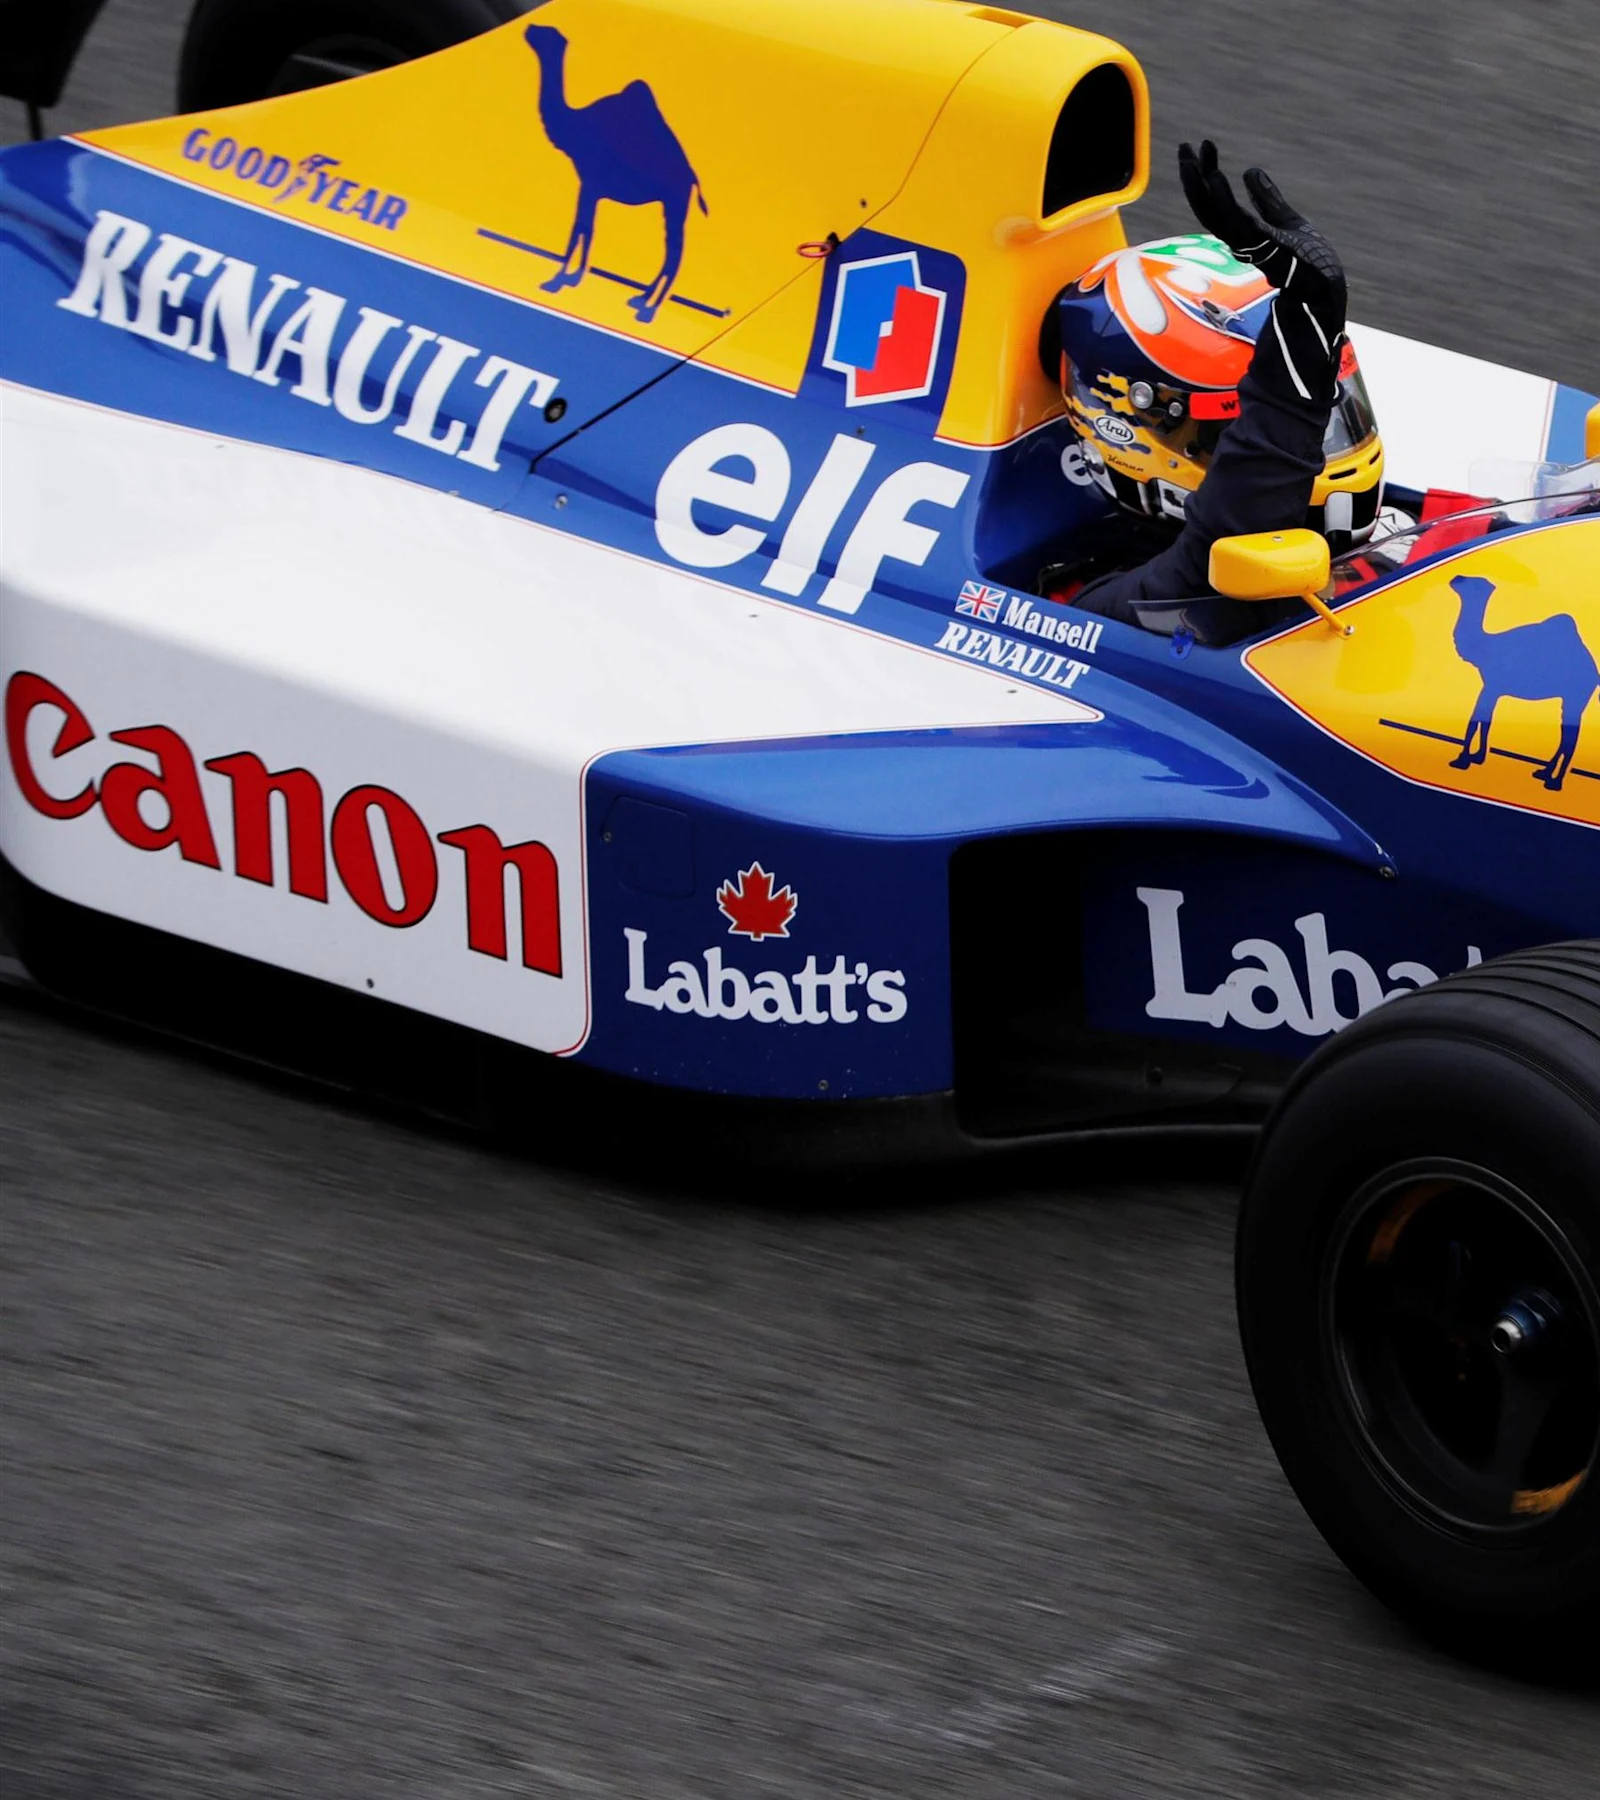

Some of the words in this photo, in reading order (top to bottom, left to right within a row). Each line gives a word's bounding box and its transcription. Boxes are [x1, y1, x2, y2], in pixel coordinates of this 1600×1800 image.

[182, 128, 408, 231] GOODYEAR
[57, 210, 559, 472] RENAULT
[1101, 420, 1129, 438] Arai
[654, 422, 971, 615] elf
[934, 620, 1089, 689] RENAULT
[1001, 596, 1104, 654] Mansell
[4, 670, 563, 979] Canon
[623, 926, 908, 1025] Labatt's
